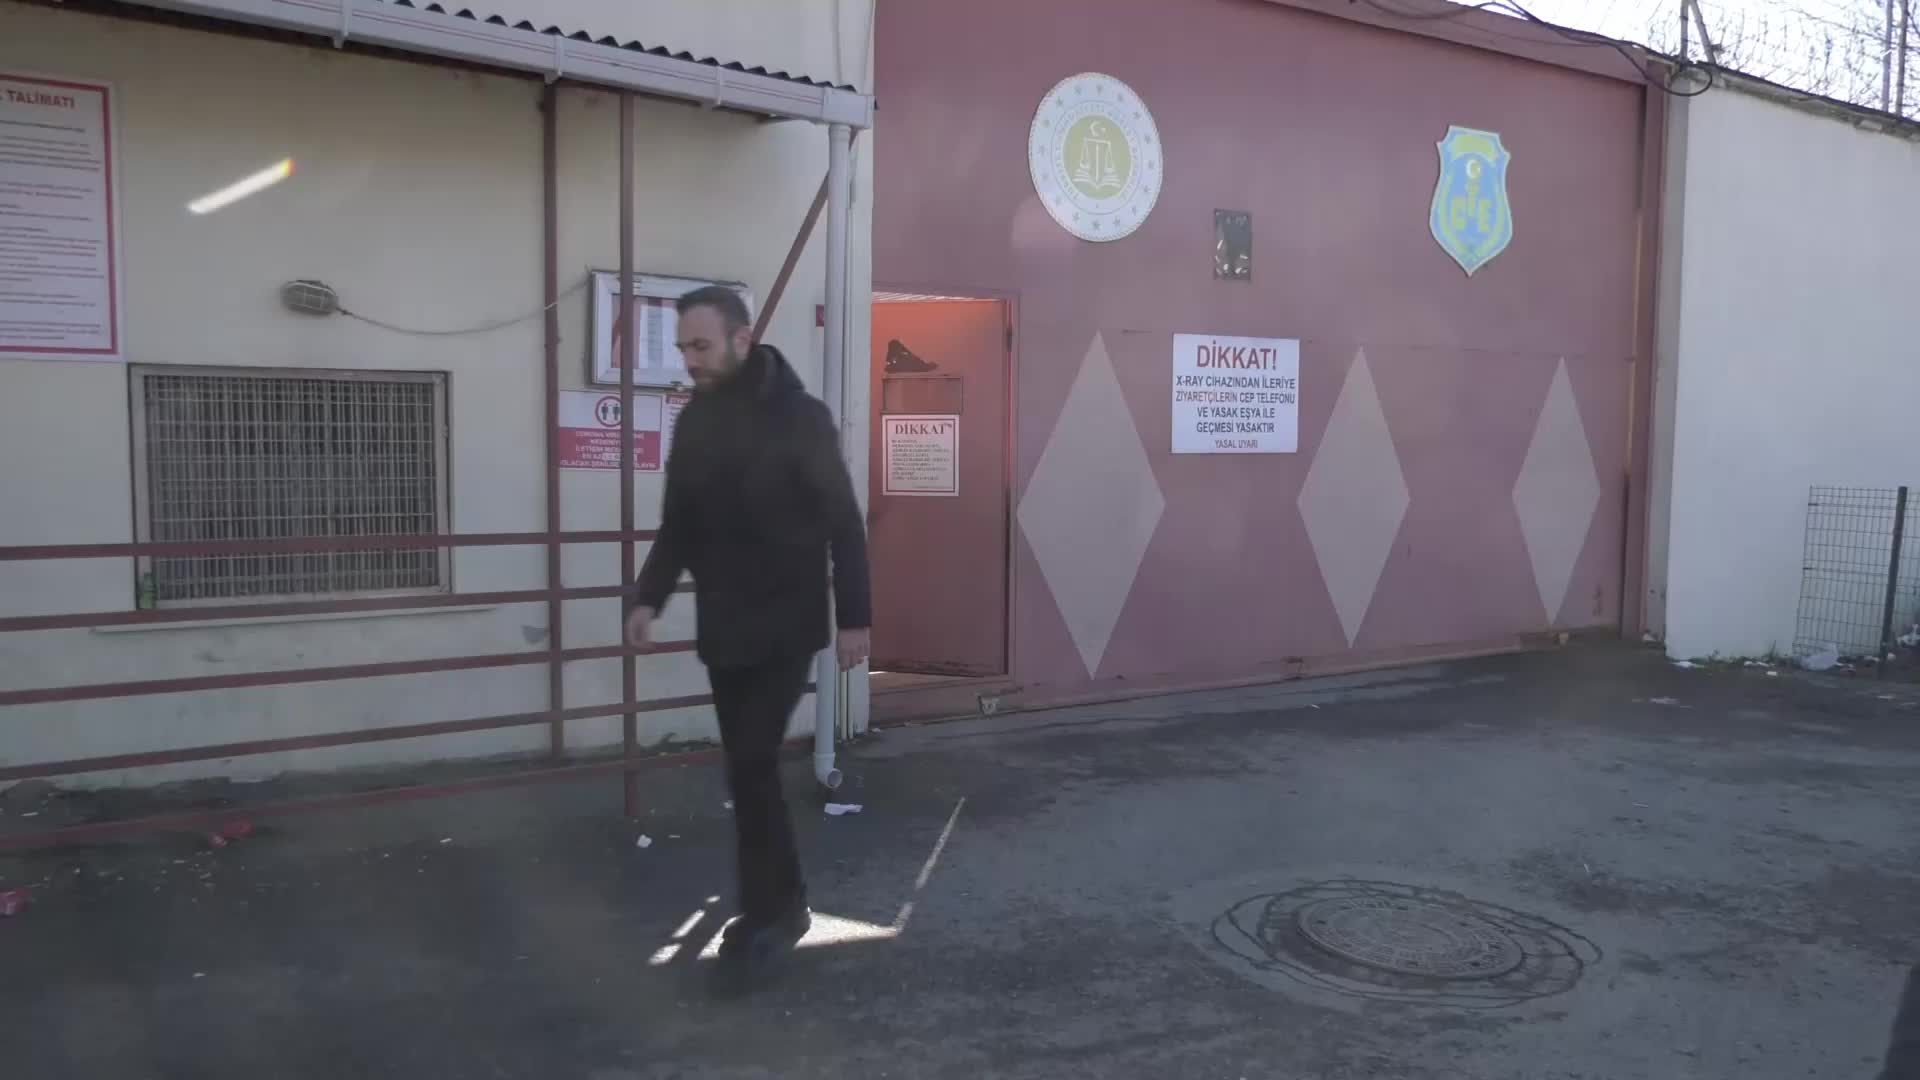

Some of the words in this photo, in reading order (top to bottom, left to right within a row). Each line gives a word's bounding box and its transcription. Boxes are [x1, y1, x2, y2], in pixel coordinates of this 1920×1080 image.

[1197, 340, 1277, 370] DİKKAT!
[1176, 376, 1204, 387] X-RAY
[1240, 392, 1255, 403] CEP
[1256, 392, 1295, 404] TELEFONU
[1197, 407, 1208, 418] VE
[1210, 407, 1238, 418] YASAK
[1240, 407, 1261, 420] EŞYA
[895, 423, 948, 435] DİKKAT
[1197, 421, 1233, 435] GEÇMESİ
[1236, 422, 1275, 433] YASAKTIR
[1215, 439, 1237, 449] YASAL
[1239, 439, 1258, 449] UYARI
